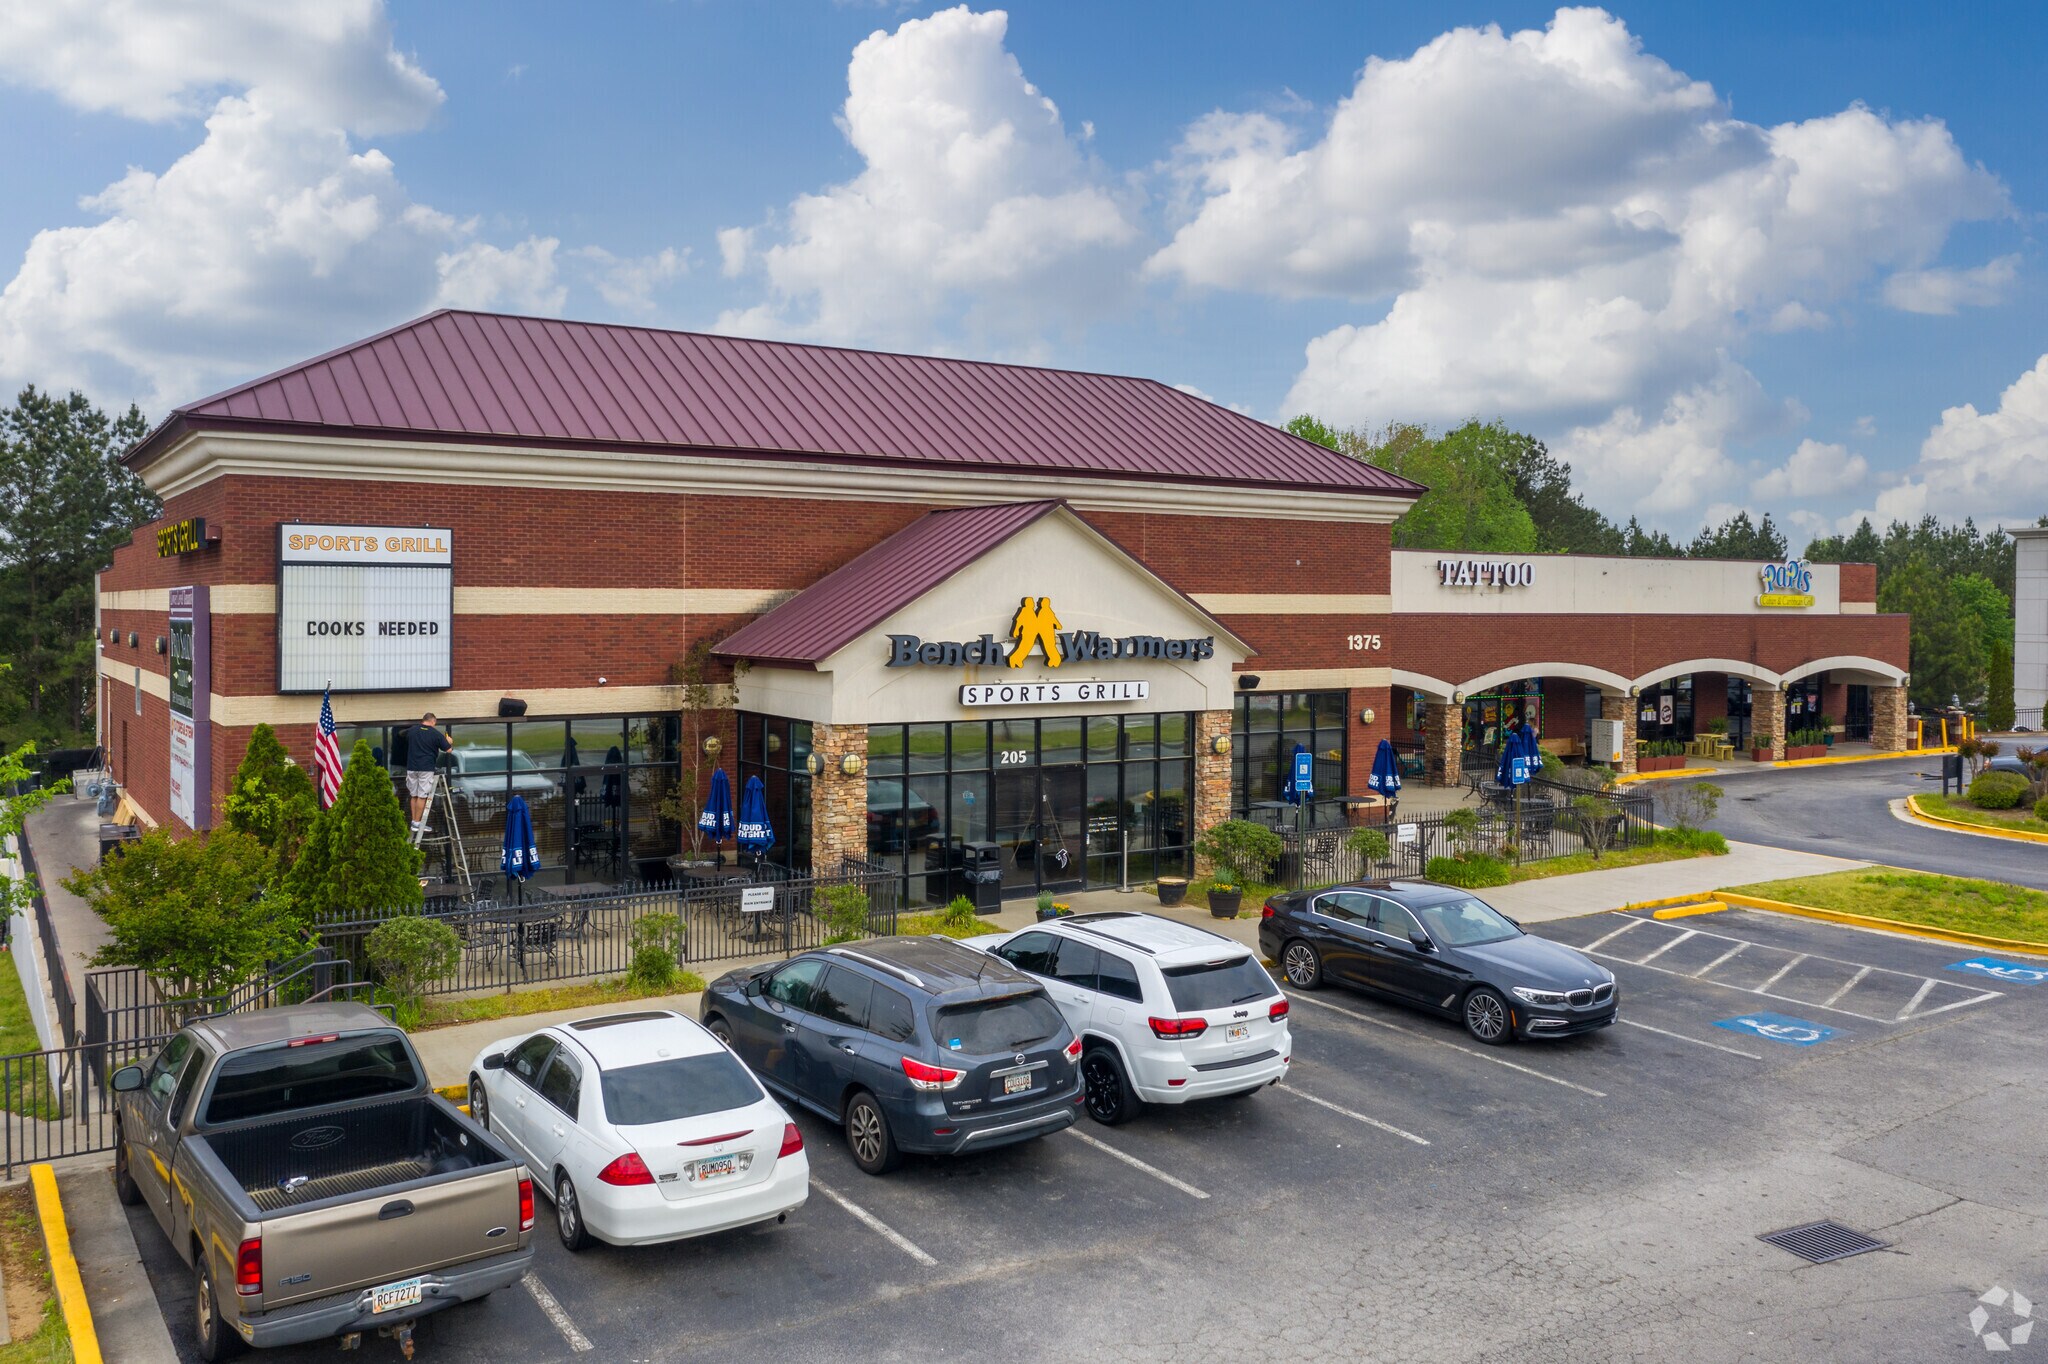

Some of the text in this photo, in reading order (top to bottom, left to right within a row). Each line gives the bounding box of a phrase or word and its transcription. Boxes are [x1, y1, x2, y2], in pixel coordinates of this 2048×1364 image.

[288, 534, 448, 553] SPORTS GRILL
[1437, 560, 1537, 587] TATTOO
[307, 621, 439, 636] COOKS NEEDED
[885, 630, 1215, 668] Bench Warmers
[1347, 634, 1381, 650] 1375
[967, 682, 1145, 704] SPORTS GRILL
[1001, 750, 1027, 764] 205
[1233, 1010, 1248, 1018] Jeep
[377, 1285, 417, 1307] RCF7277
